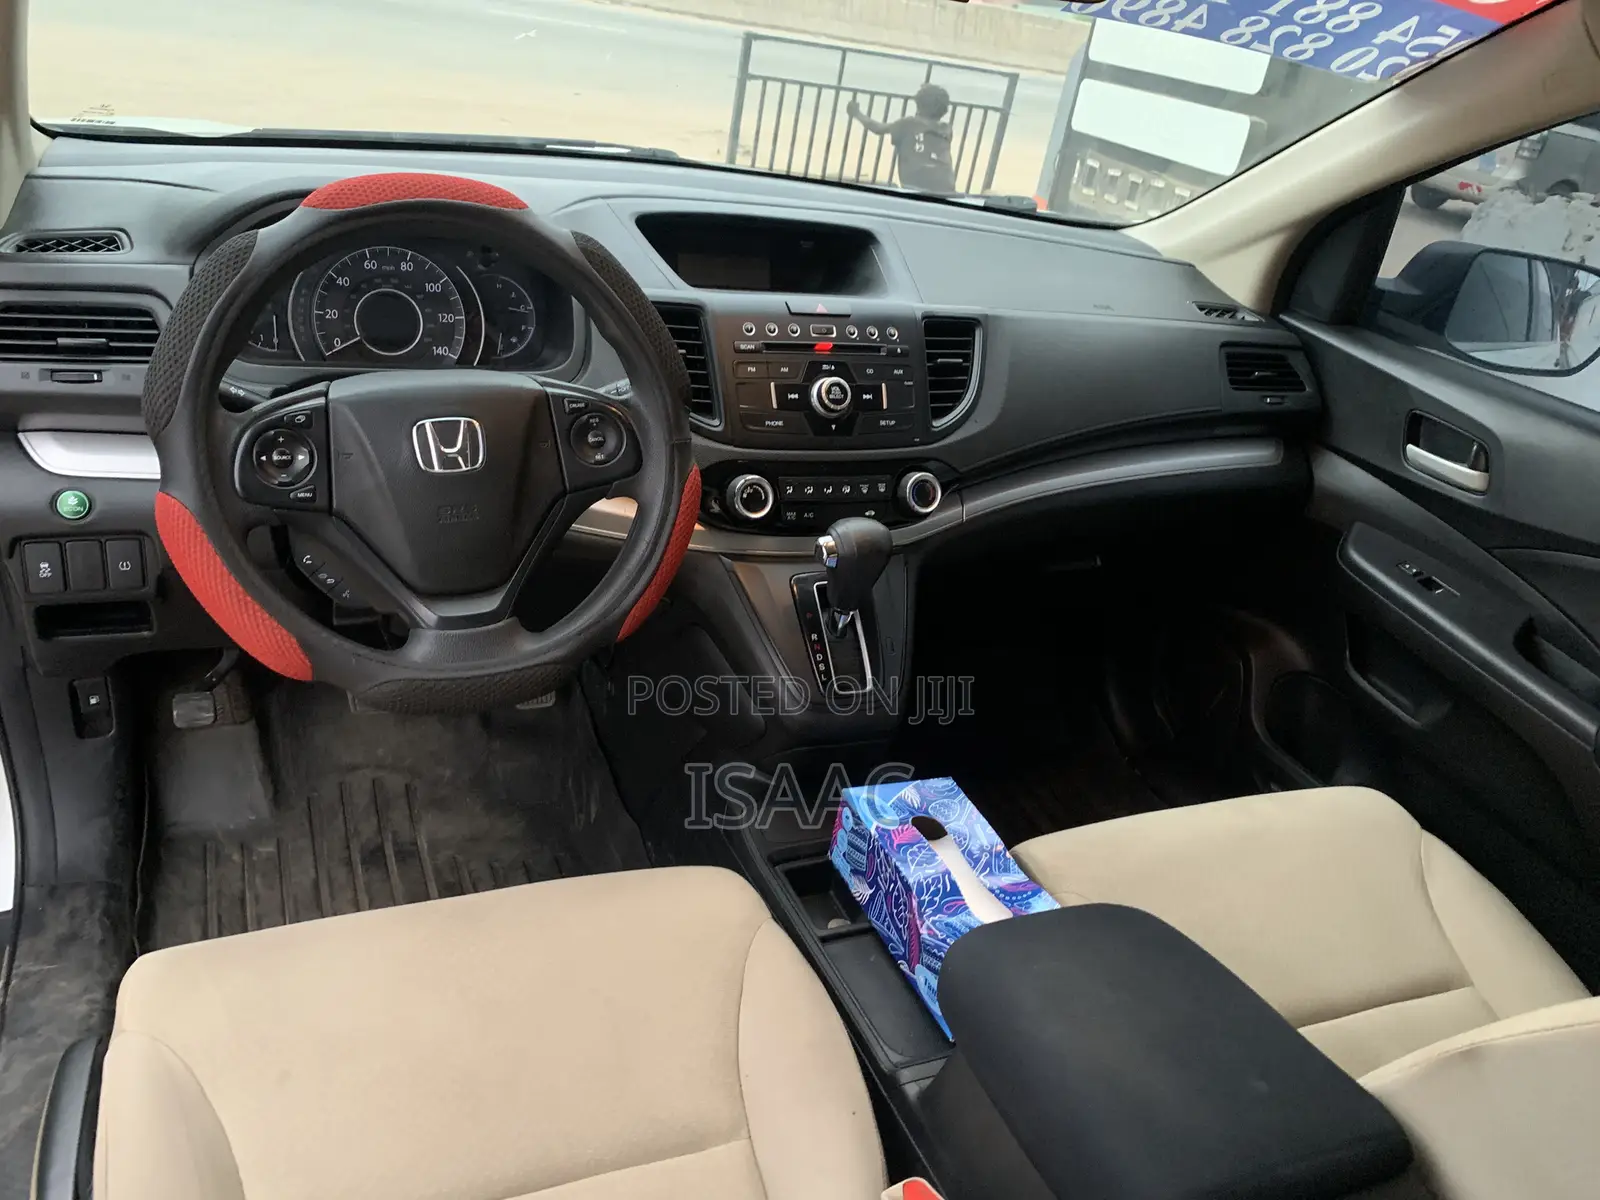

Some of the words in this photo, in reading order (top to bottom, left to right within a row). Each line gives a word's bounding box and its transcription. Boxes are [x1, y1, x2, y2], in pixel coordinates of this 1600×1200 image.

[364, 260, 377, 270] 60
[400, 262, 414, 271] 80
[336, 276, 350, 287] 40
[425, 283, 442, 292] 100
[325, 309, 338, 319] 20
[438, 313, 455, 323] 120
[333, 337, 341, 347] 0
[432, 346, 449, 356] 140
[811, 633, 818, 641] R
[816, 653, 823, 661] D
[821, 673, 827, 681] L
